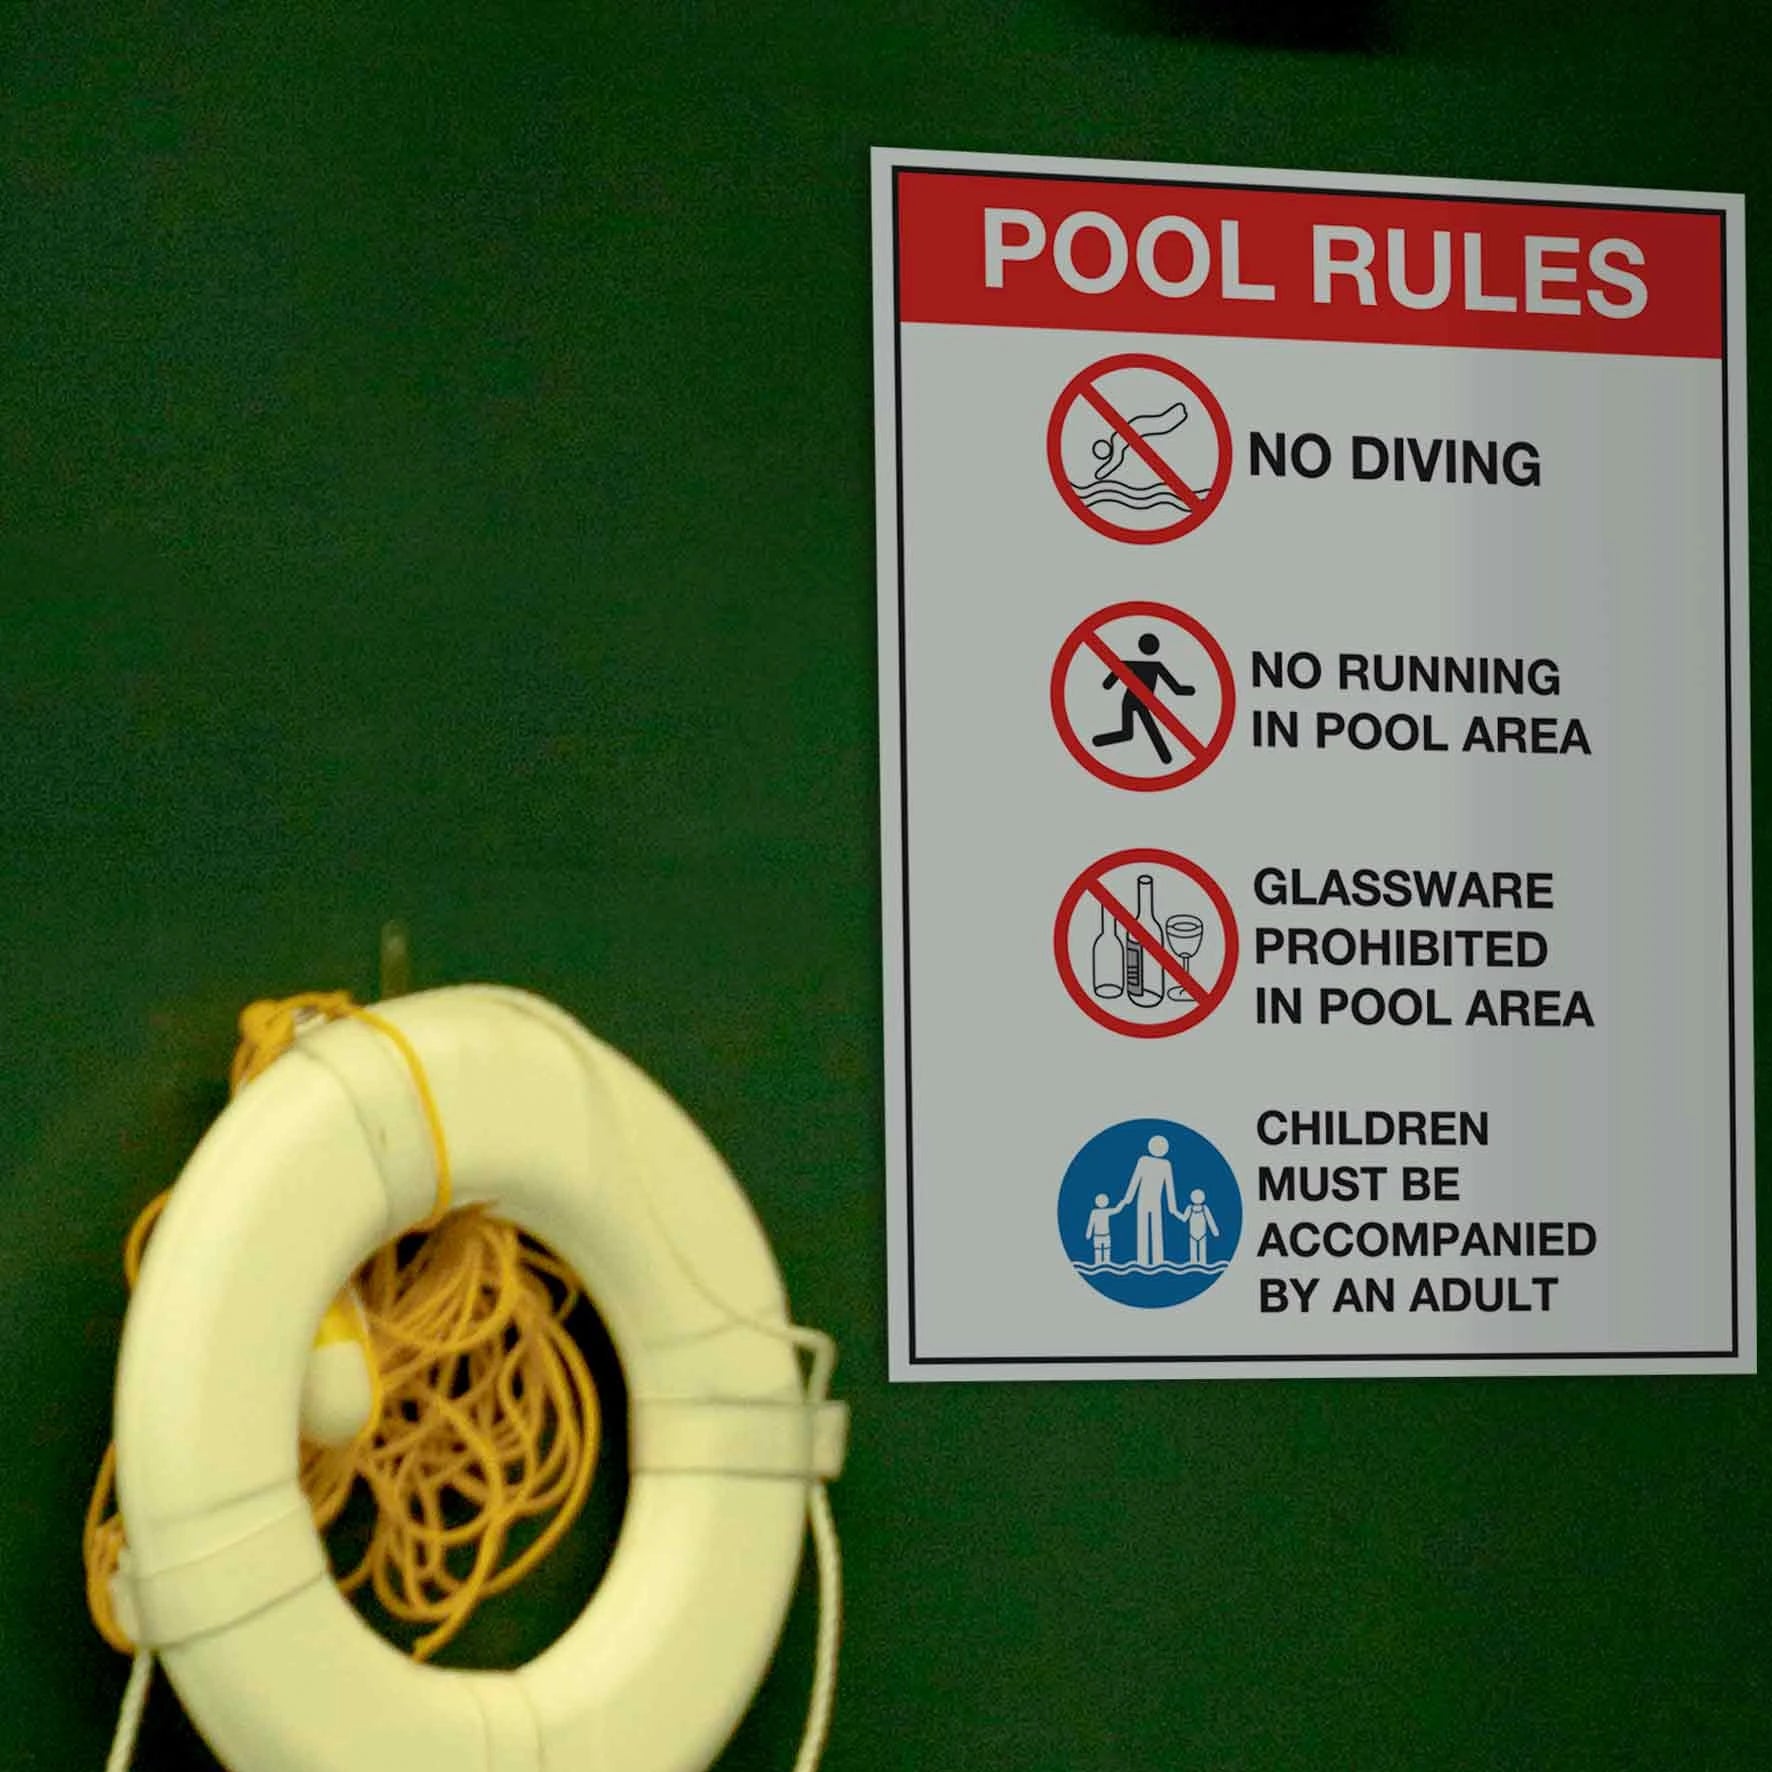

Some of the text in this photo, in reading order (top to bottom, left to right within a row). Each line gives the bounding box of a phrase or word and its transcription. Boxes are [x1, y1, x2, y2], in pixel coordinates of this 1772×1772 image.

[985, 208, 1647, 318] POOL RULES
[1250, 432, 1540, 486] NO DIVING
[1253, 651, 1559, 695] NO RUNNING
[1253, 711, 1591, 755] IN POOL AREA
[1254, 868, 1553, 908] GLASSWARE
[1256, 928, 1547, 967] PROHIBITED
[1257, 988, 1594, 1027] IN POOL AREA
[1257, 1110, 1488, 1145] CHILDREN
[1259, 1166, 1459, 1201] MUST BE
[1257, 1222, 1596, 1257] ACCOMPANIED
[1261, 1277, 1558, 1312] BY AN ADULT
